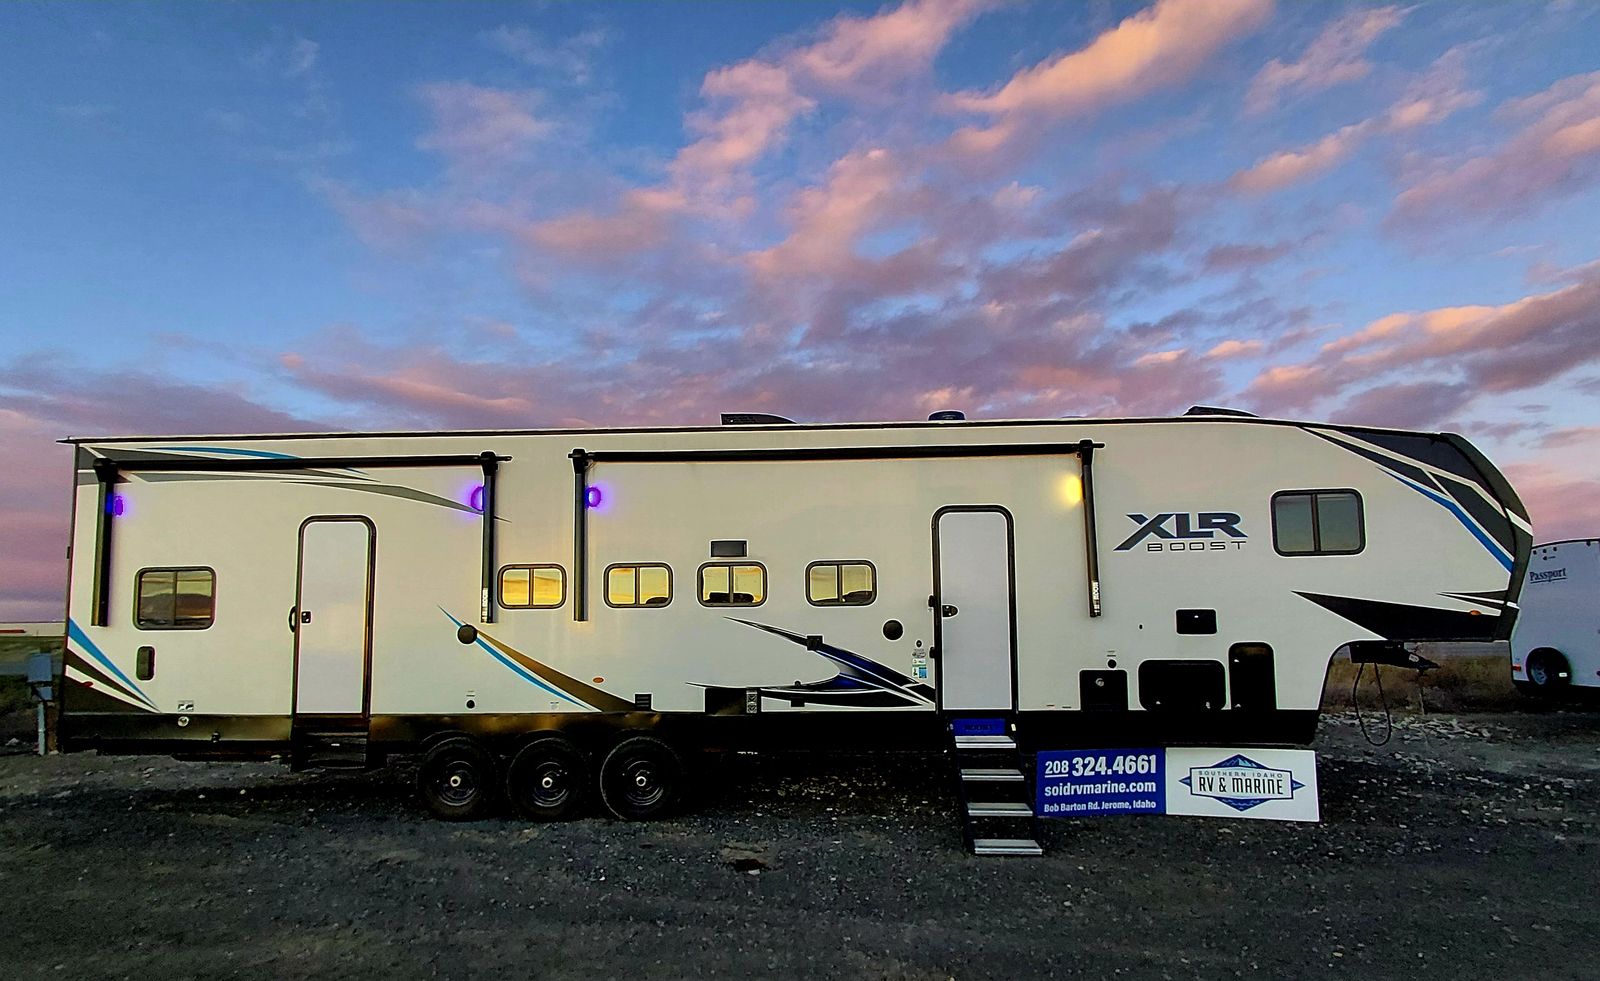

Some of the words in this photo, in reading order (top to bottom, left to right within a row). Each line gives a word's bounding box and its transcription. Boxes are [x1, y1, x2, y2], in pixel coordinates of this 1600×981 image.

[1113, 512, 1248, 551] XLR
[1147, 541, 1247, 552] BOOST
[1529, 568, 1566, 582] Passport
[1045, 760, 1069, 774] 208
[1072, 755, 1156, 777] 324.4661
[1044, 781, 1156, 797] soidrvmarine.com
[1199, 777, 1214, 792] RV
[1218, 778, 1227, 793] &
[1232, 778, 1283, 794] MARINE
[1044, 804, 1059, 813] Bob
[1060, 803, 1086, 812] Barton
[1088, 802, 1100, 810] Rd.
[1101, 801, 1131, 810] Jerome,
[1133, 800, 1156, 809] Idaho
